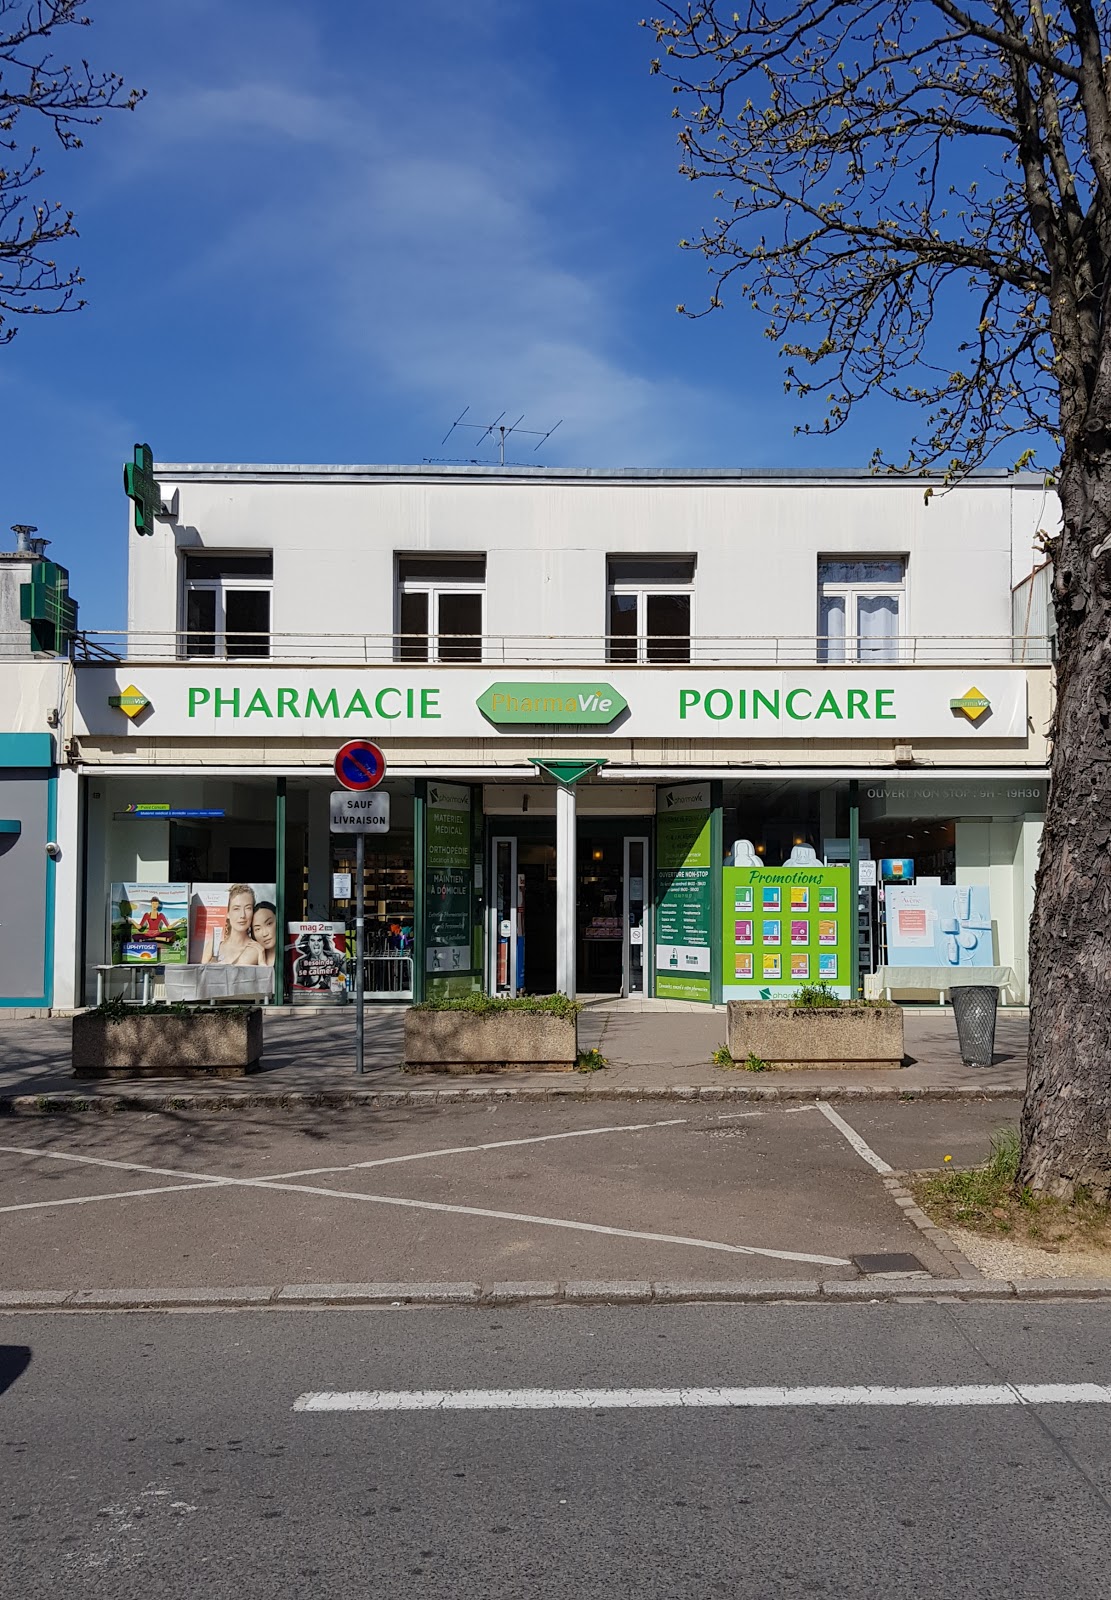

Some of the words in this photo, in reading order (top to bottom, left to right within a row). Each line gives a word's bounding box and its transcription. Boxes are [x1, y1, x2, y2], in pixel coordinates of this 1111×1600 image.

[188, 687, 442, 718] PHARMACIE
[492, 691, 613, 712] PharmaVie
[679, 688, 897, 719] POINCARE
[1007, 788, 1041, 798] 19H30
[347, 800, 373, 809] SAUF
[333, 816, 386, 825] LIVRAISON
[433, 874, 464, 884] MAINTIEN
[685, 870, 709, 878] NON-STOP
[749, 870, 824, 885] Promotions
[436, 886, 467, 895] DOMICILE
[300, 924, 317, 933] mag
[319, 923, 325, 931] 2
[303, 959, 325, 967] Besoin
[308, 968, 334, 976] calmer
